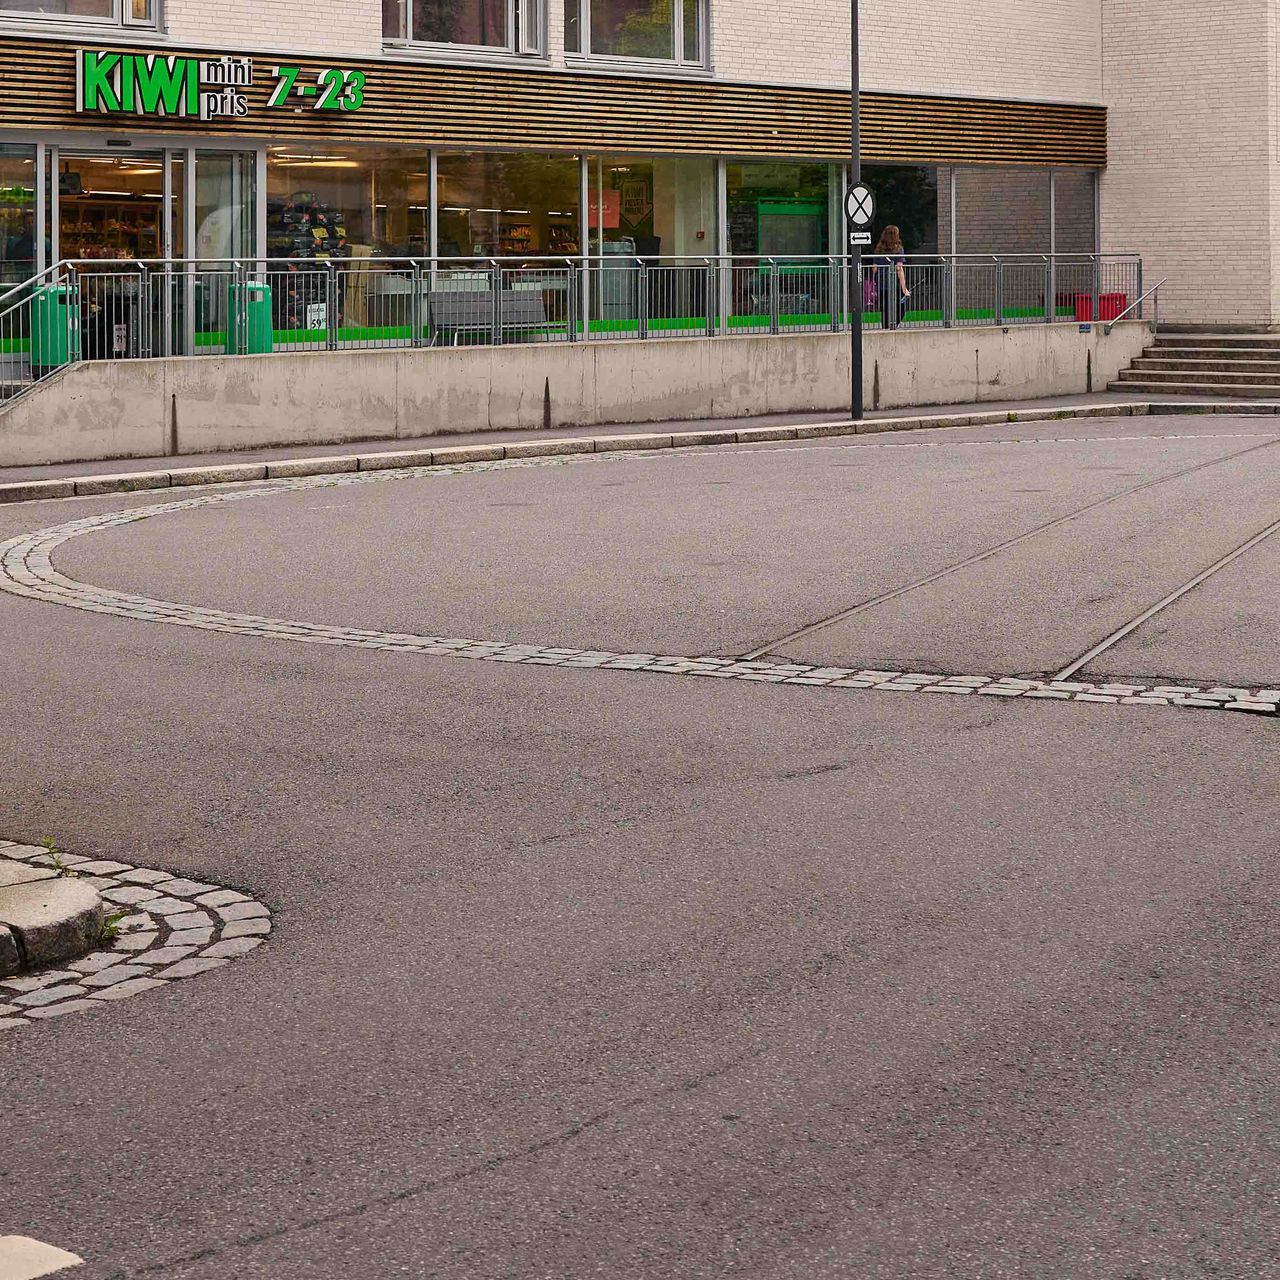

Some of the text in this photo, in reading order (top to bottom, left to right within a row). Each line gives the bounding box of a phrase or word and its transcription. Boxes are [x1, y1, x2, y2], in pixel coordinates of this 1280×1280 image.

[76, 50, 200, 119] KIWI
[202, 56, 253, 86] mini
[202, 87, 248, 120] pris
